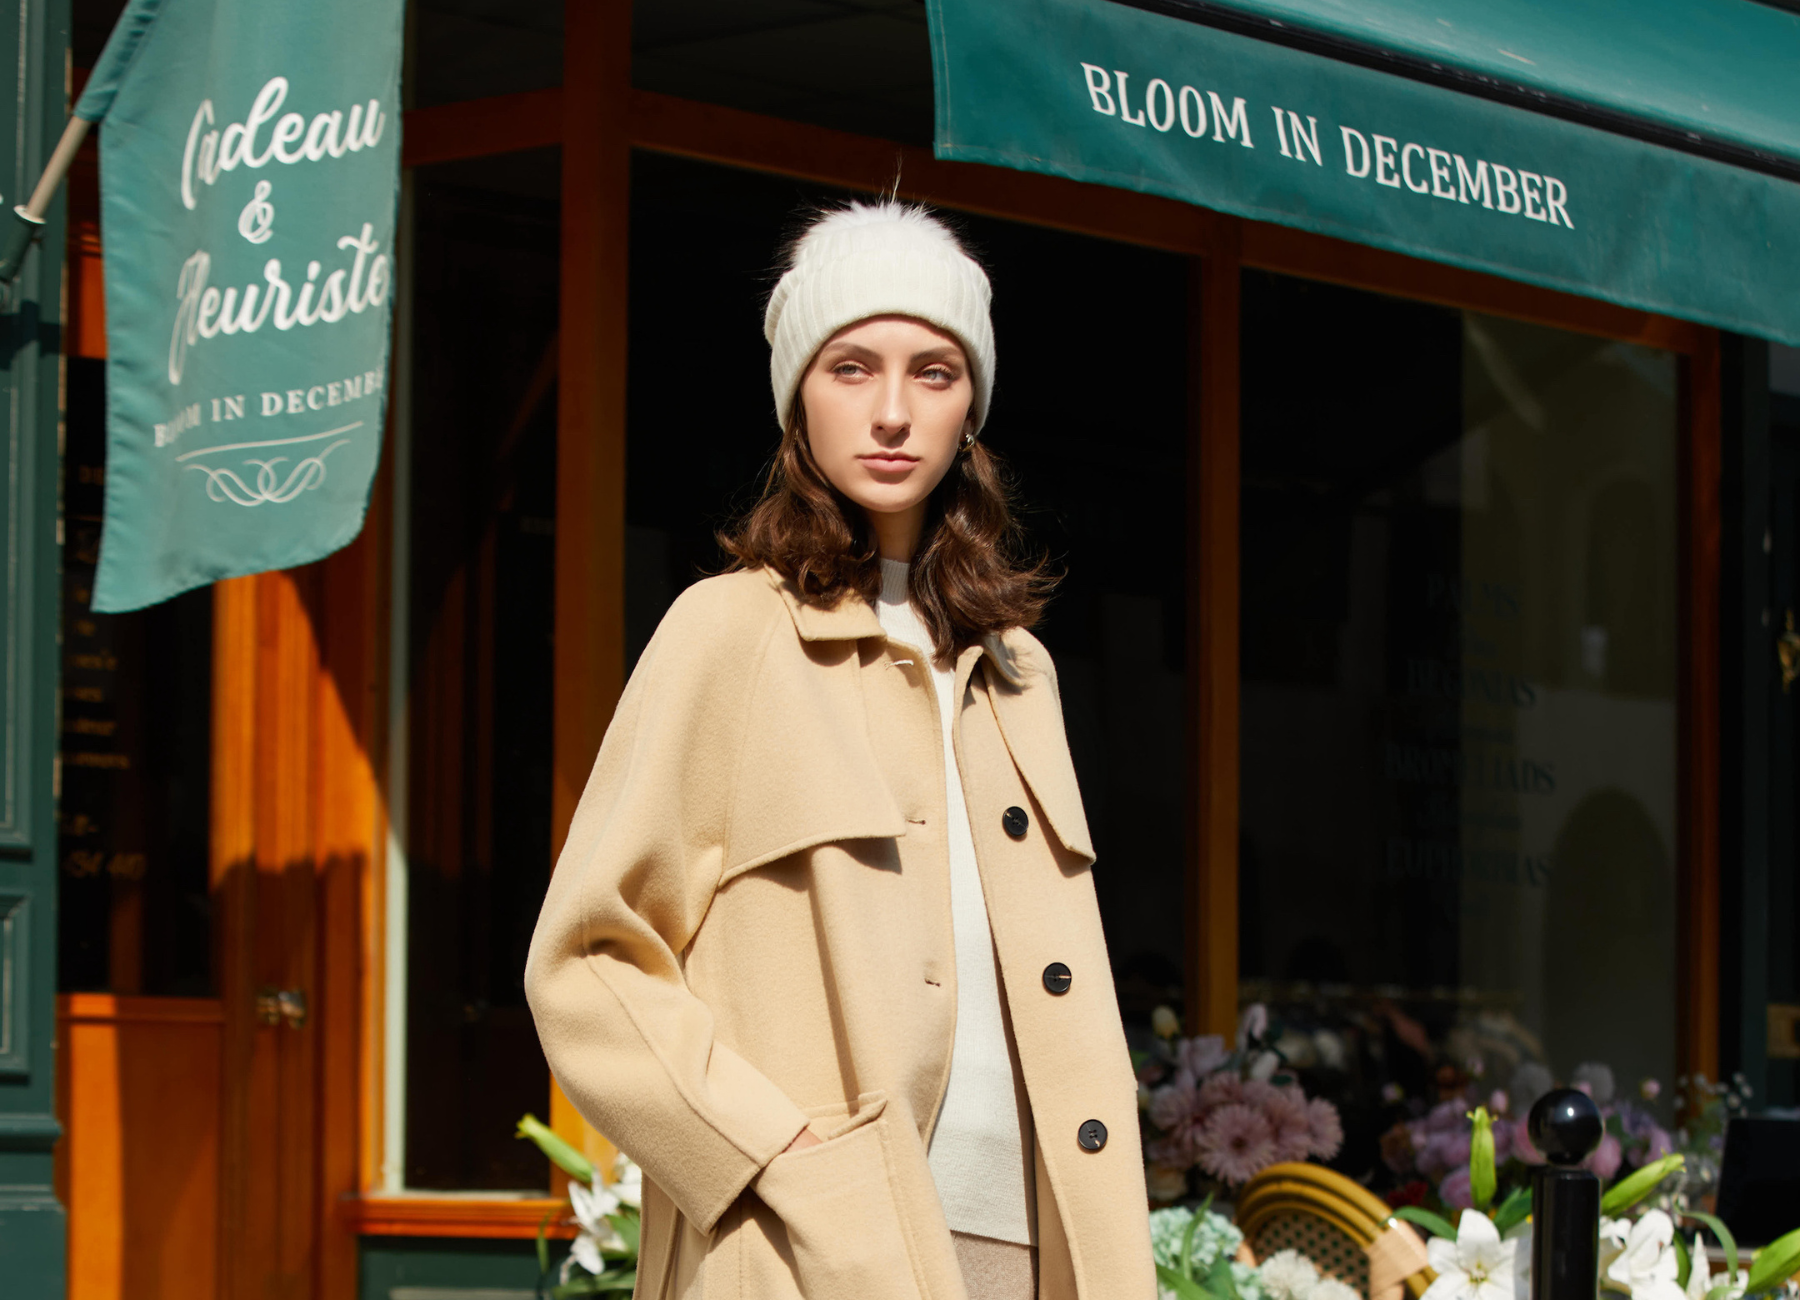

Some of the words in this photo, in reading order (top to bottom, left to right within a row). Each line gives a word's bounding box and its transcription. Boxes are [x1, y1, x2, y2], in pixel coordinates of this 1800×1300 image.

[1080, 62, 1255, 149] BLOOM
[1271, 106, 1323, 167] IN
[1339, 126, 1576, 230] DECEMBER
[238, 179, 275, 245] &
[211, 395, 246, 423] IN
[260, 366, 384, 418] DECEMB
